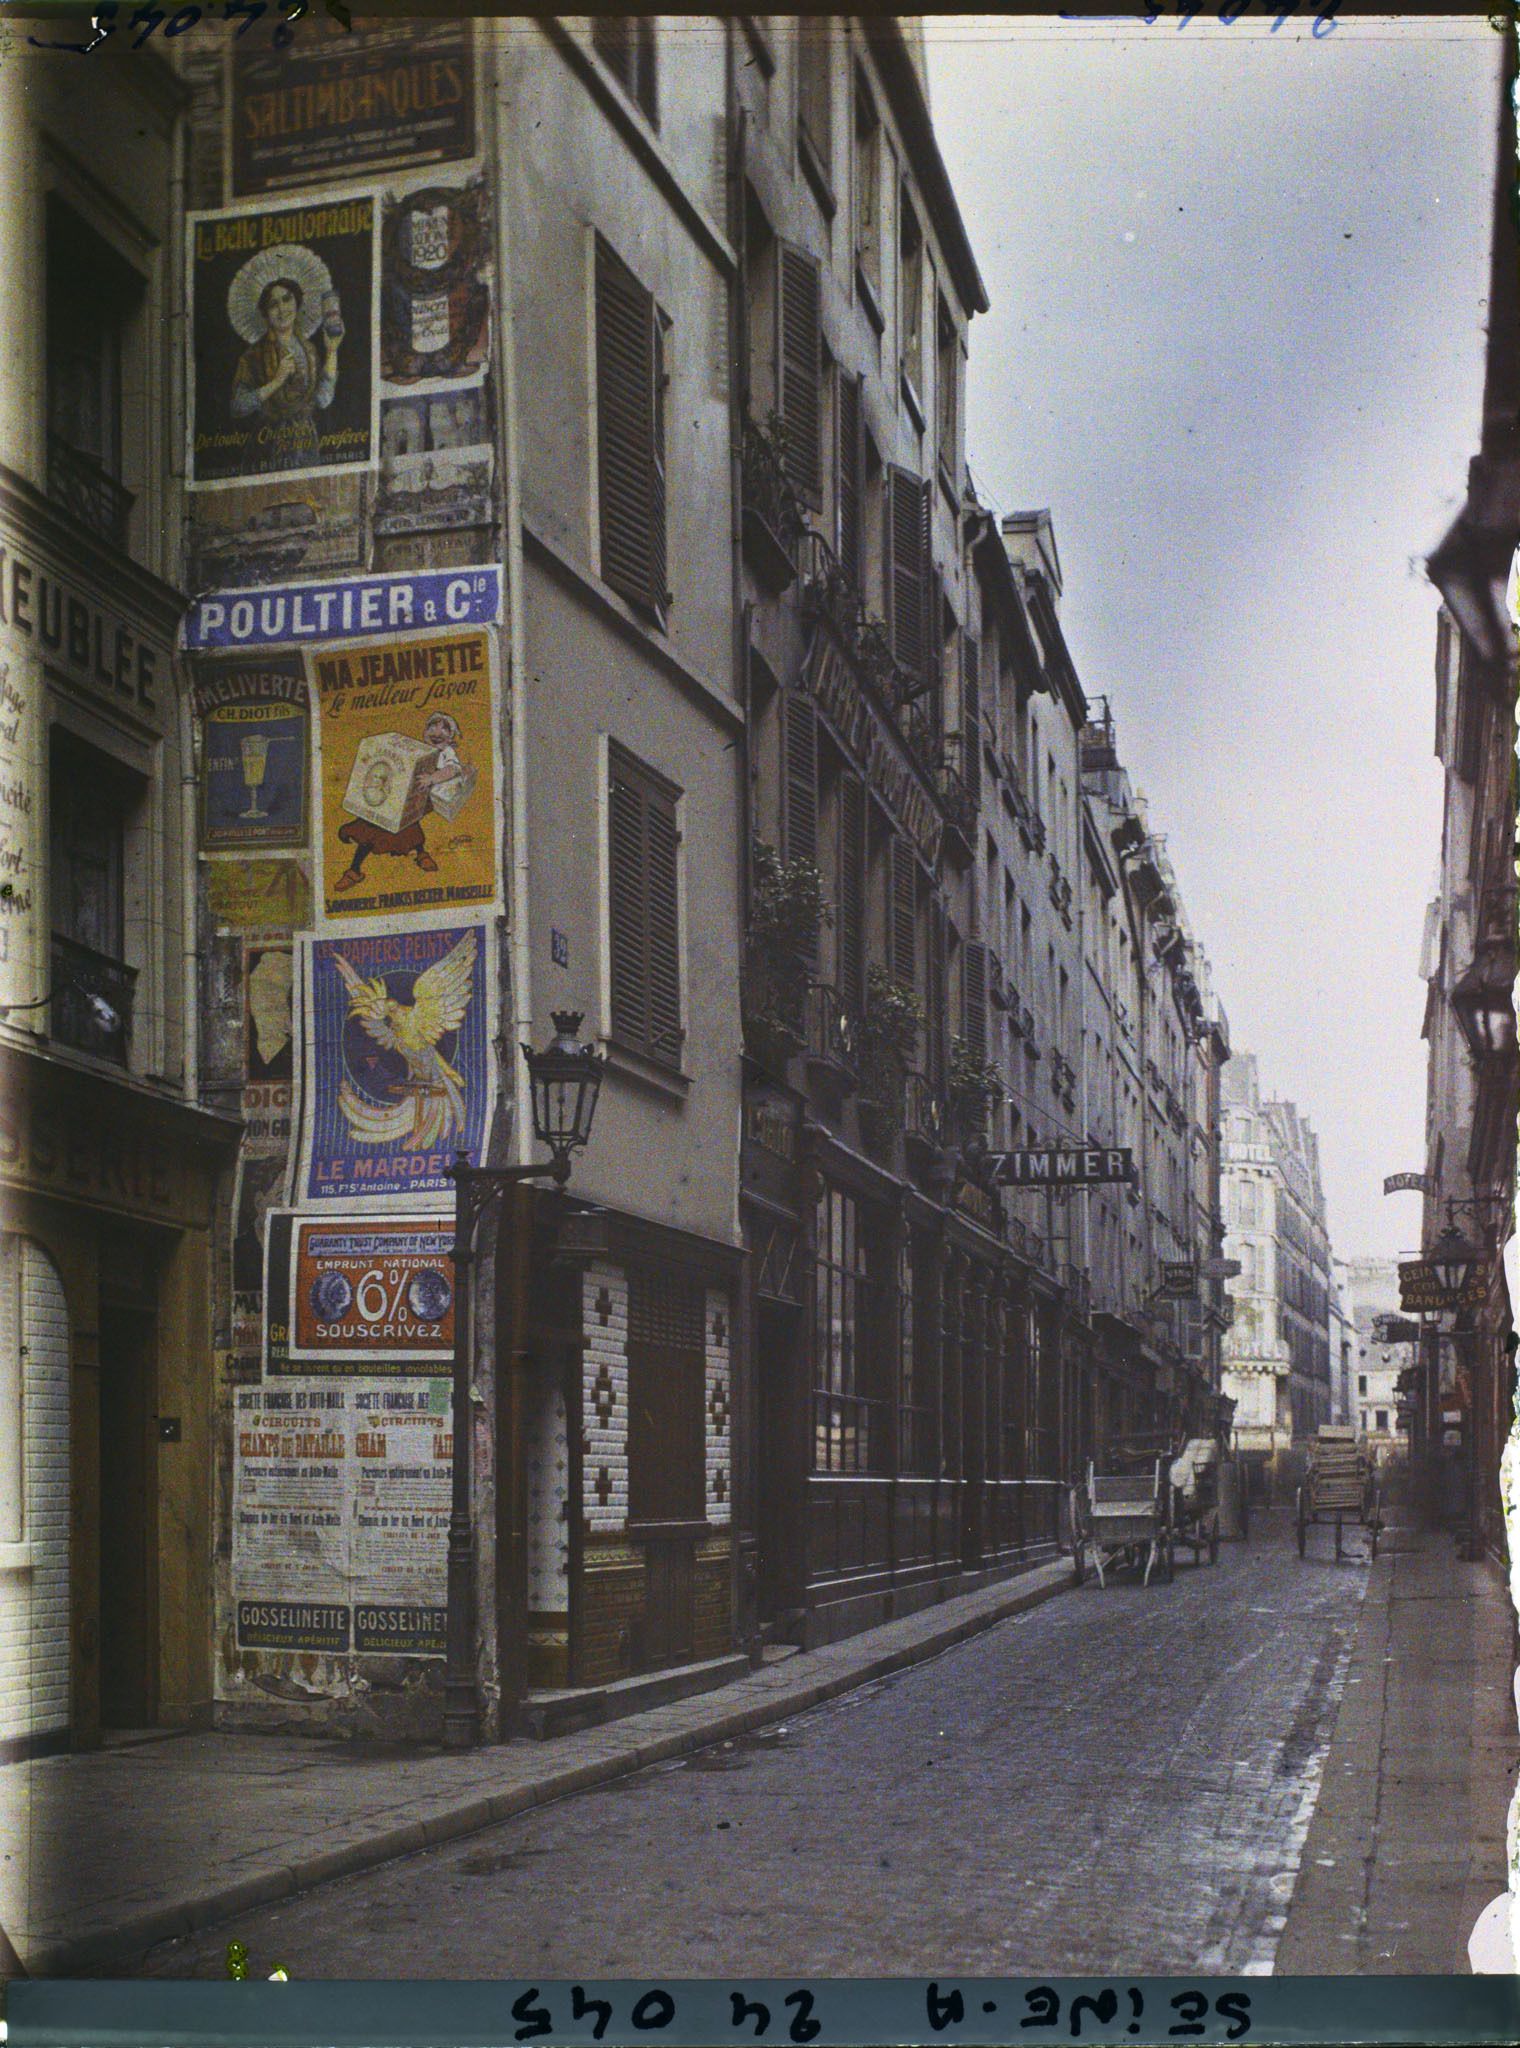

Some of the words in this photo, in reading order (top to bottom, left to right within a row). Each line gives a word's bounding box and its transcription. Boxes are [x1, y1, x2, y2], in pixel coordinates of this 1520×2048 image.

[245, 60, 464, 139] SALTIMBANQUES
[199, 584, 414, 640] POULTIER
[423, 599, 437, 622] &
[318, 659, 353, 691] MA
[357, 640, 484, 687] JEANNETTE
[351, 681, 421, 710] meilleur
[405, 932, 453, 960] PEINTS
[315, 1159, 345, 1181] LE
[990, 1150, 1124, 1181] ZIMMER
[360, 1182, 400, 1193] Antoine
[410, 1178, 447, 1189] PARIS
[316, 1259, 375, 1270] EMPRUNT
[383, 1258, 445, 1269] NATIONAL
[316, 1323, 442, 1338] SOUSCRIVEZ
[262, 1416, 321, 1428] CIRCUITS
[381, 1416, 444, 1429] CIRCUITS
[239, 1433, 280, 1458] CHAMPS
[295, 1433, 345, 1459] BATAILLE
[241, 1606, 346, 1630] GOSSELINETTE
